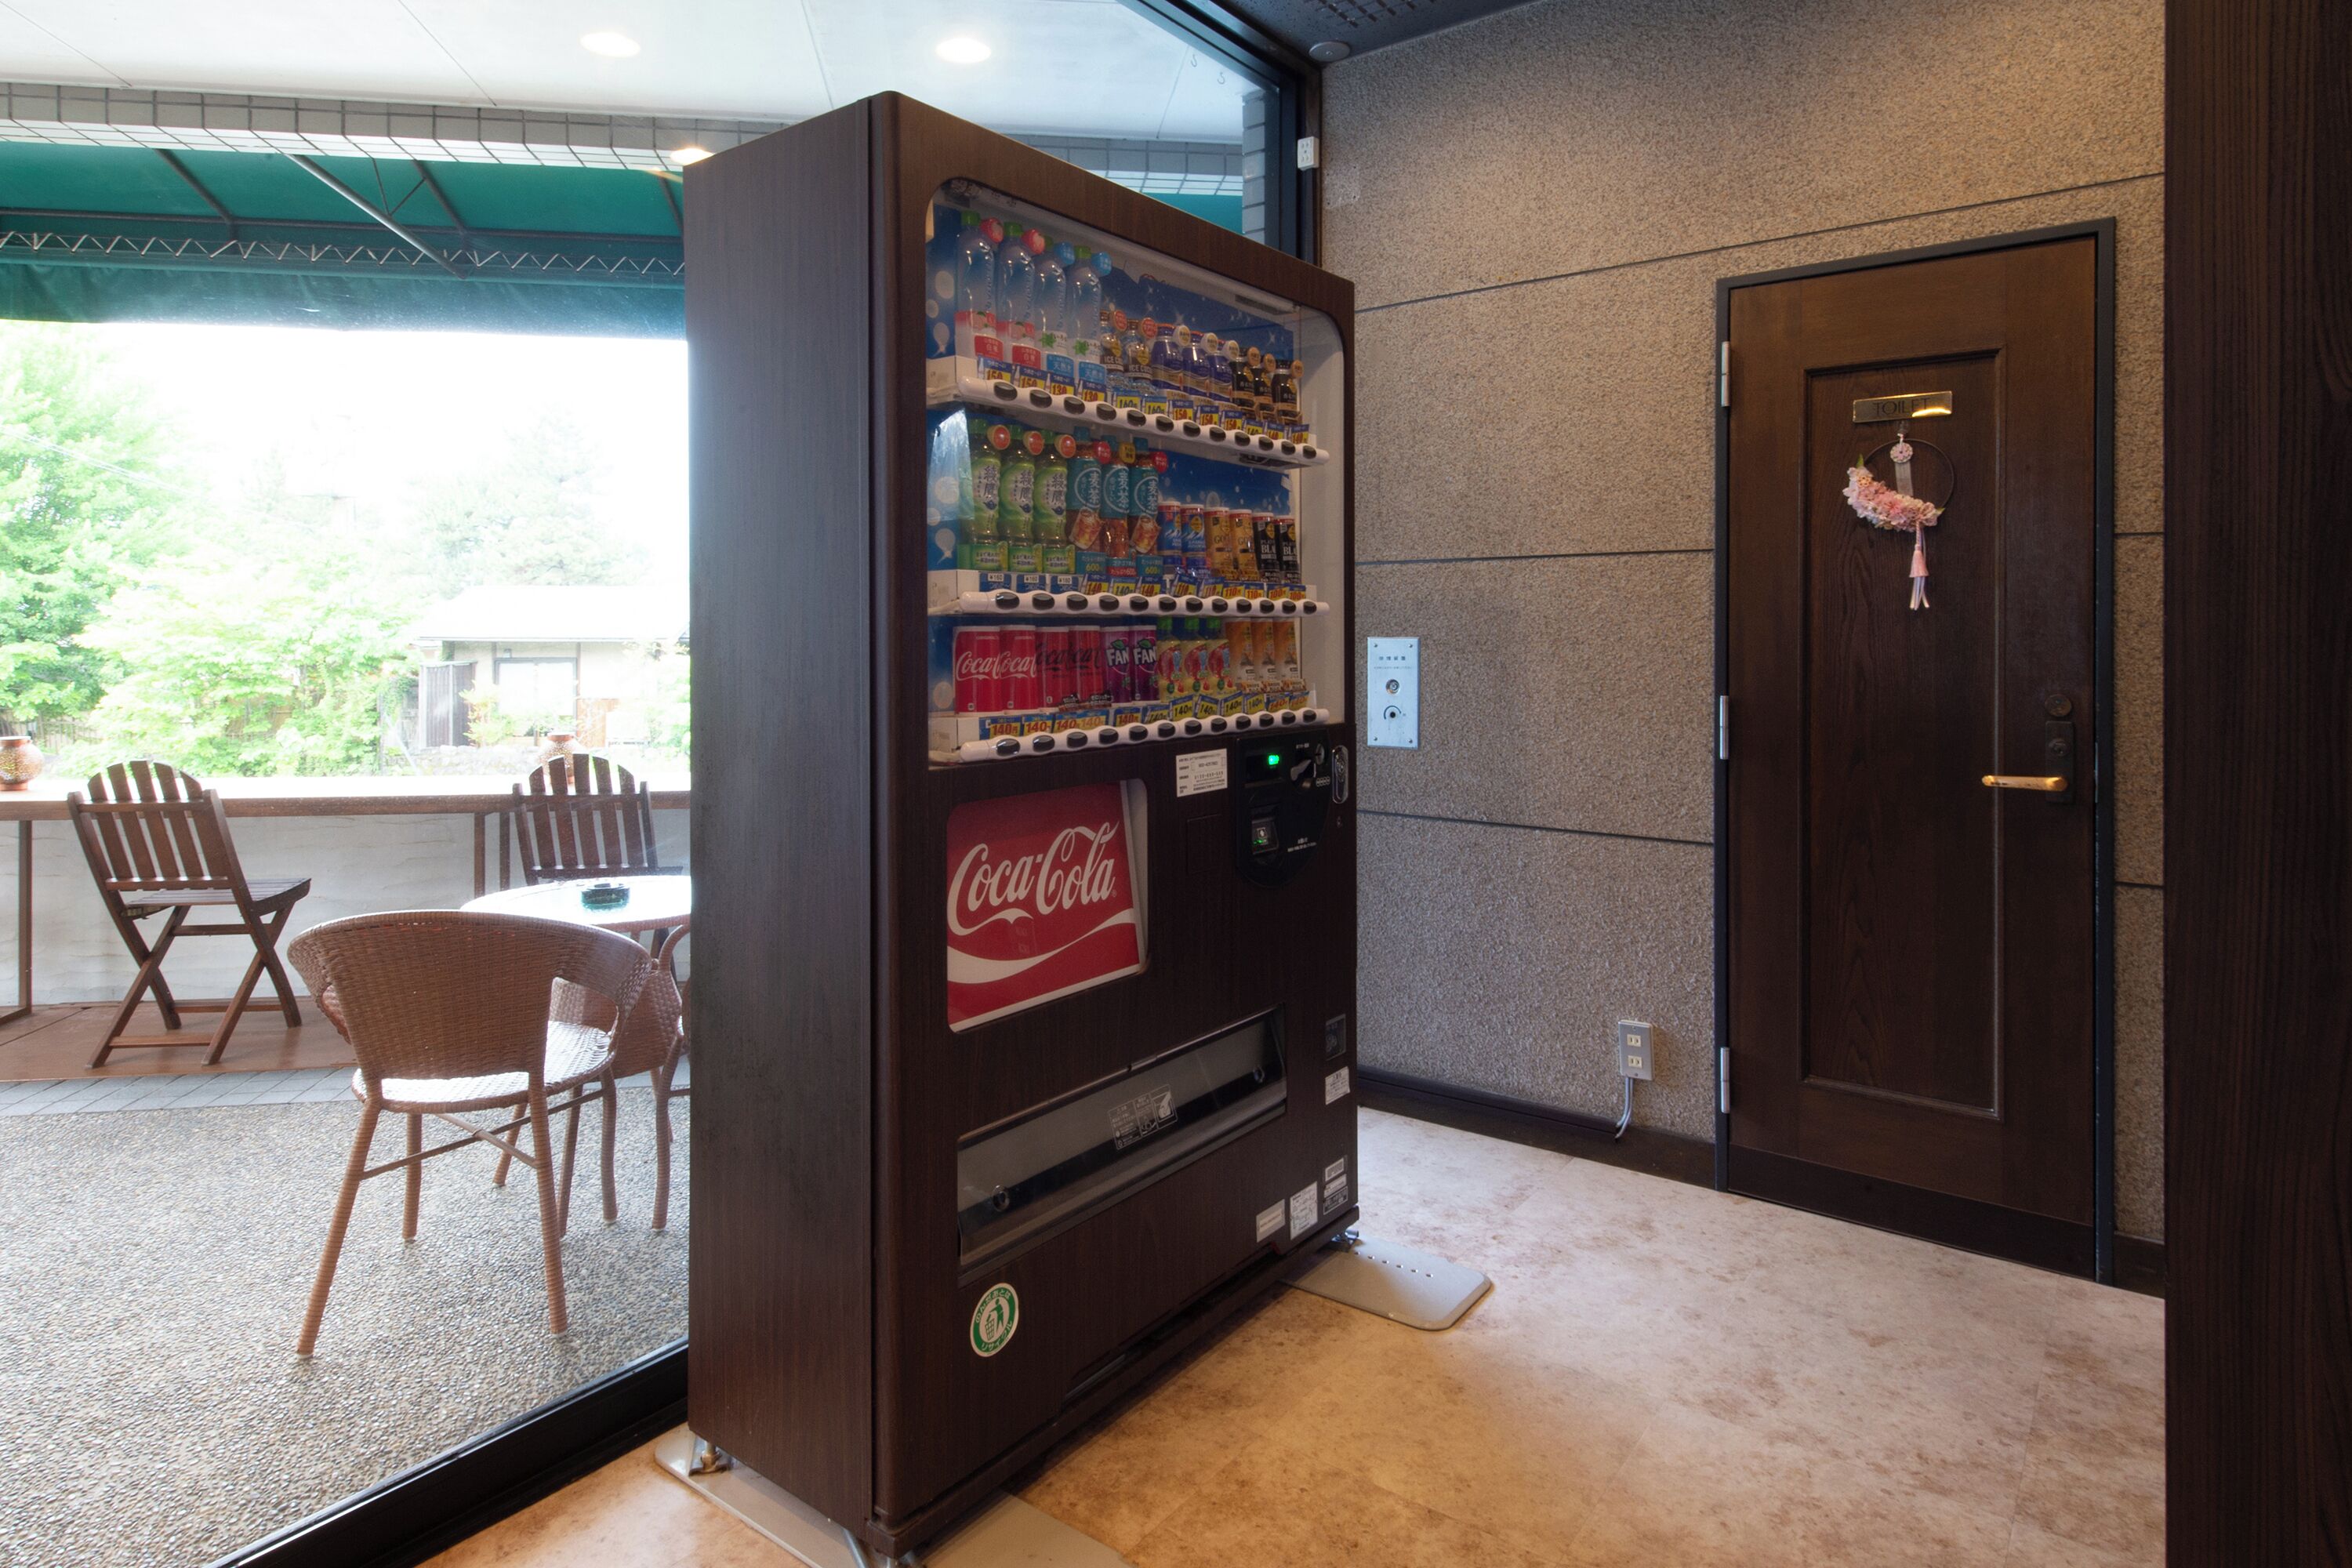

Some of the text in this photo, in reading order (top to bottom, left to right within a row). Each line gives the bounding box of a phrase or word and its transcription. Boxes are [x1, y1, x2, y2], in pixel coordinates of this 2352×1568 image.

[1872, 397, 1930, 417] TOILET
[984, 466, 997, 499] 綾鷹
[1019, 470, 1032, 502] 綾鷹
[1052, 473, 1065, 505] 綾鷹
[1088, 472, 1100, 504] 麦茶
[1117, 471, 1129, 509] 麦茶
[1147, 480, 1158, 510] 麦茶
[947, 821, 1120, 936] Coca-Cola
